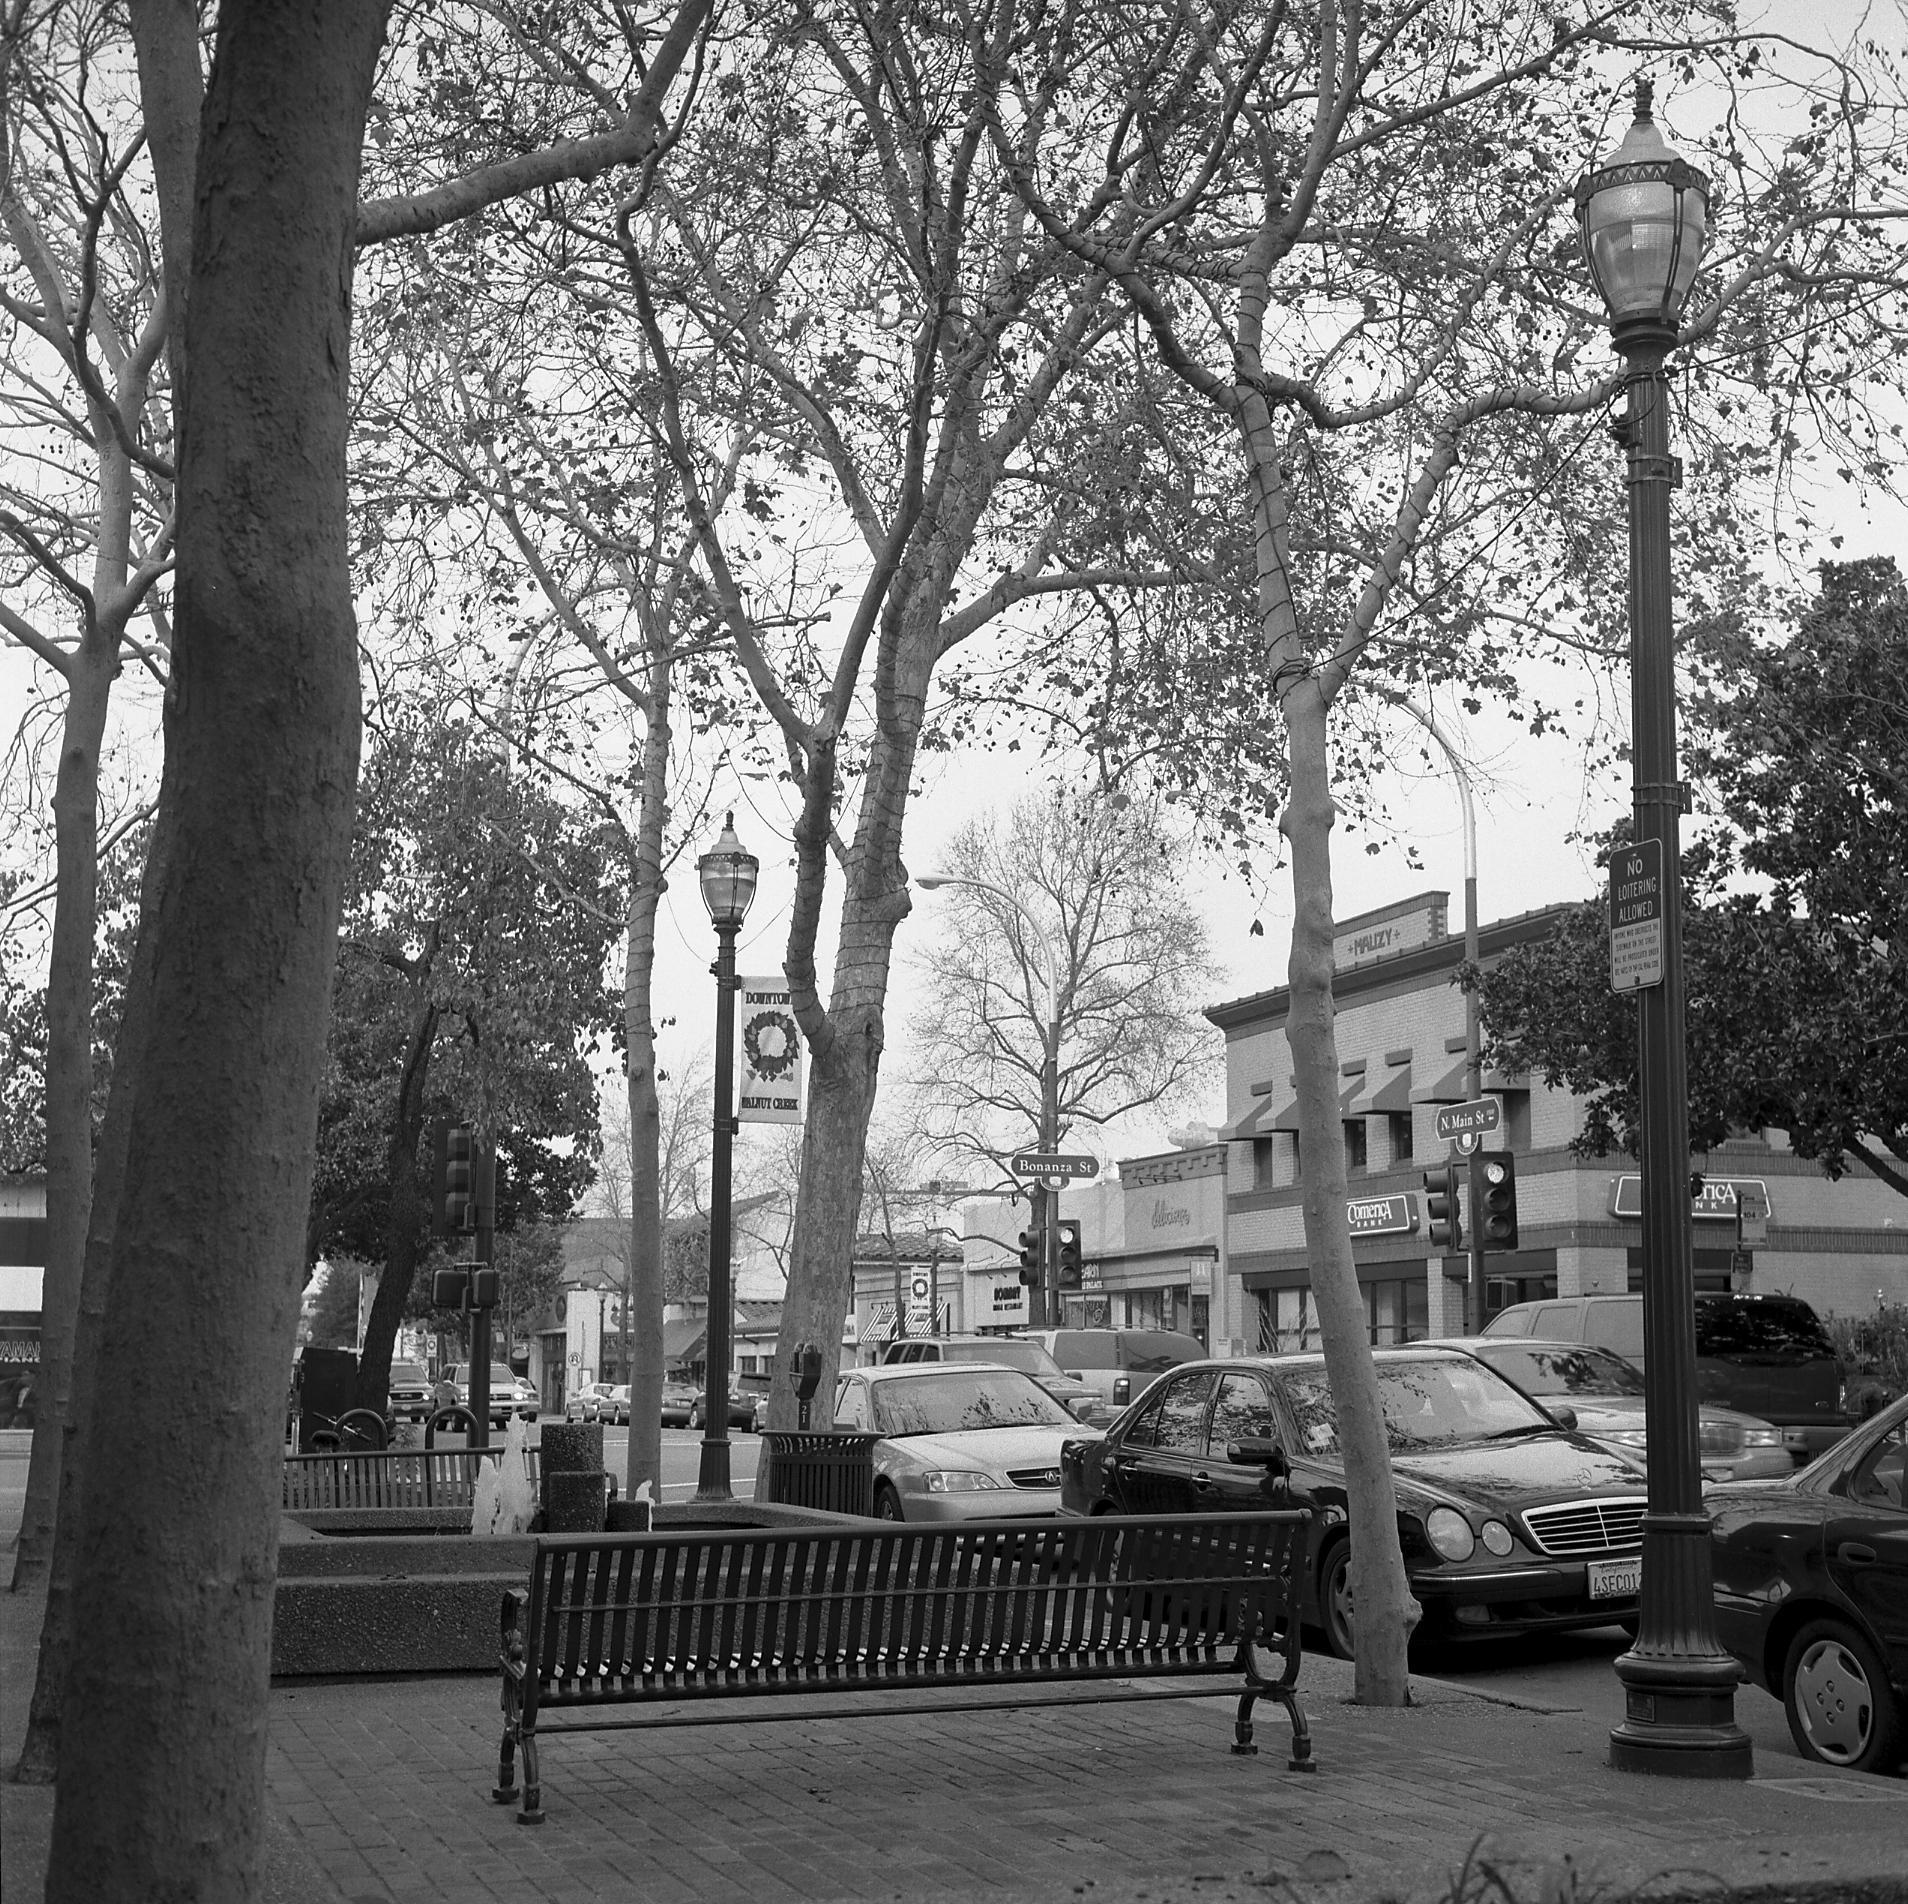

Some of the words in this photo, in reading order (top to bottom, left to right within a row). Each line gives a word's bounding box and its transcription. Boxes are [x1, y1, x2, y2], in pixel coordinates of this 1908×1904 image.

[1627, 858, 1643, 877] NO
[1618, 876, 1657, 901] LOITERING
[1618, 900, 1653, 923] ALLOWED
[745, 992, 792, 1005] DOWNTOW
[741, 1096, 772, 1109] WALNUT
[773, 1097, 799, 1110] CREEK
[1451, 1114, 1473, 1130] Main
[1475, 1110, 1485, 1125] St
[1019, 1159, 1073, 1173] Bonanza
[1079, 1161, 1092, 1173] St
[1594, 1572, 1641, 1592] 4SEC01
